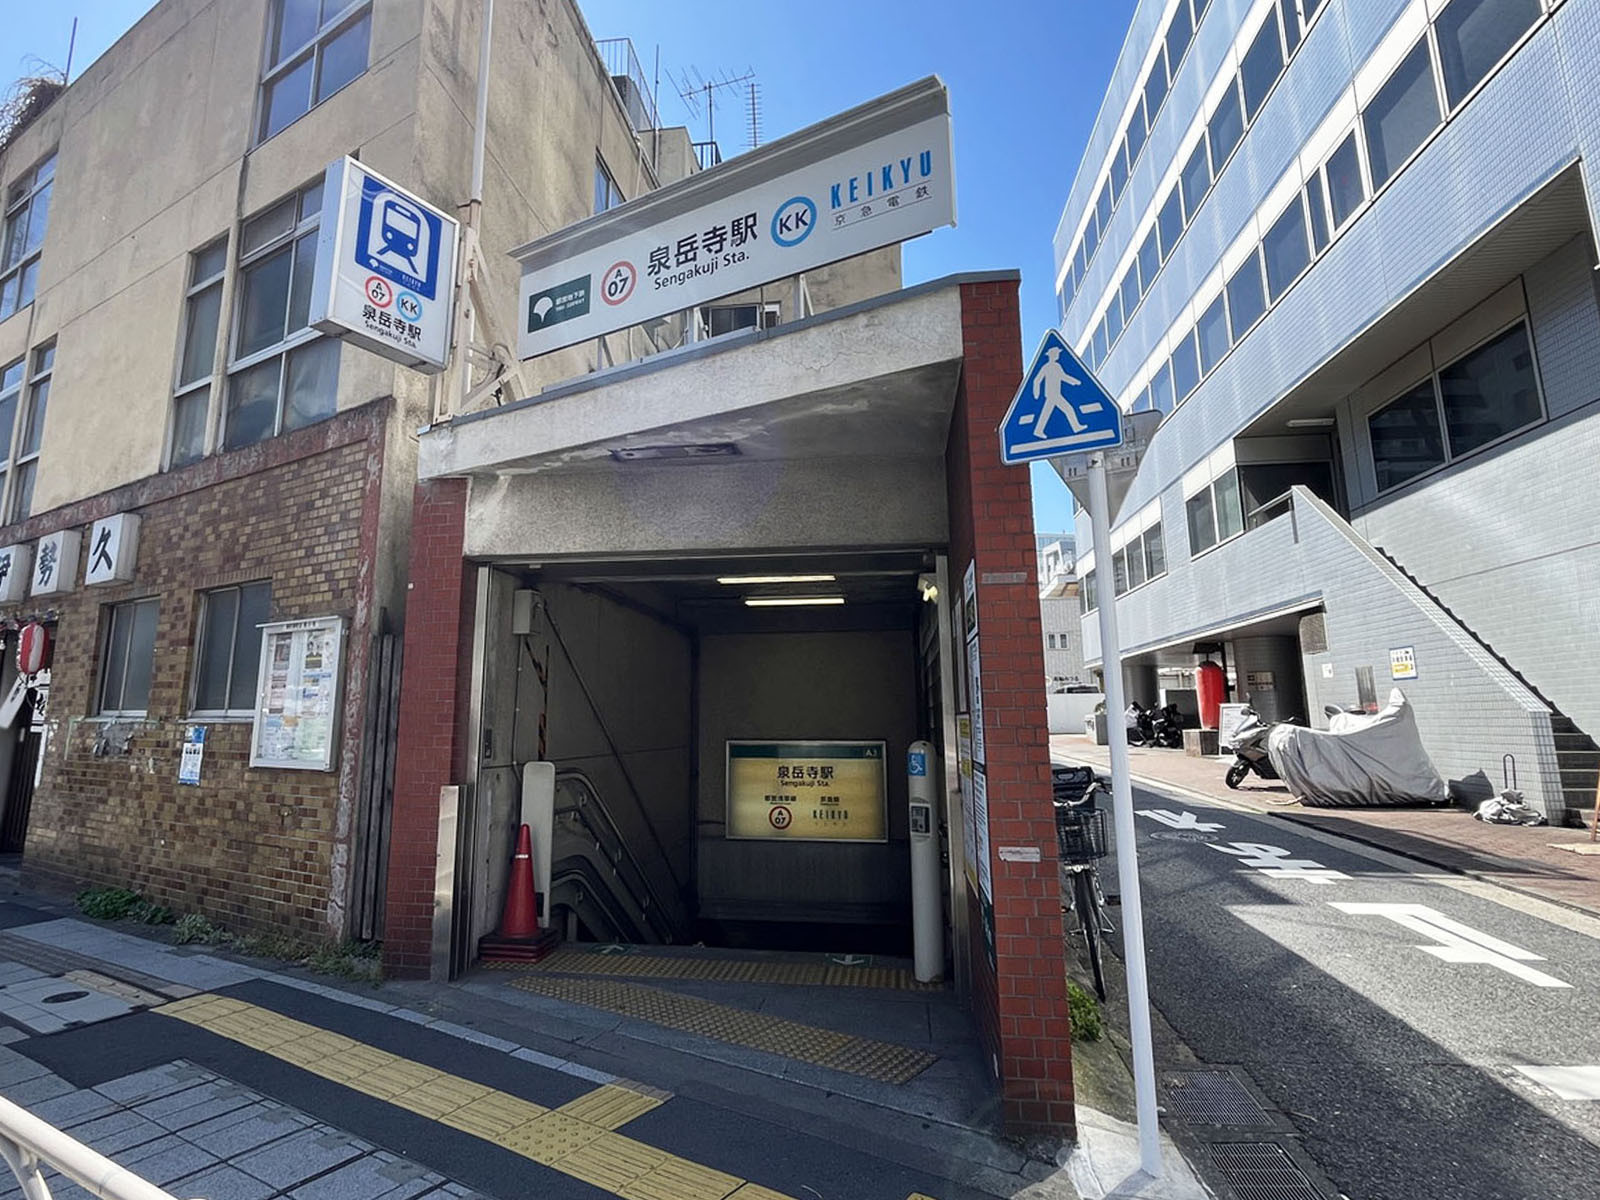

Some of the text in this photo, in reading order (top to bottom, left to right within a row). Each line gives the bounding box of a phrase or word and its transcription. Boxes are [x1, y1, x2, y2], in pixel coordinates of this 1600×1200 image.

[830, 150, 932, 210] KEIKYU
[834, 185, 930, 226] 京急電鉄
[778, 208, 809, 235] KK
[647, 212, 758, 276] 泉岳寺駅
[614, 268, 623, 279] A
[654, 251, 750, 290] Sengakuji Sta.
[371, 289, 385, 301] 07
[375, 282, 383, 291] A
[607, 276, 629, 297] 07
[400, 298, 418, 316] KK
[362, 304, 422, 341] 泉岳寺駅
[364, 319, 402, 344] Sengakuji
[777, 766, 834, 779] 泉岳寺駅
[780, 779, 815, 788] Sengakuji
